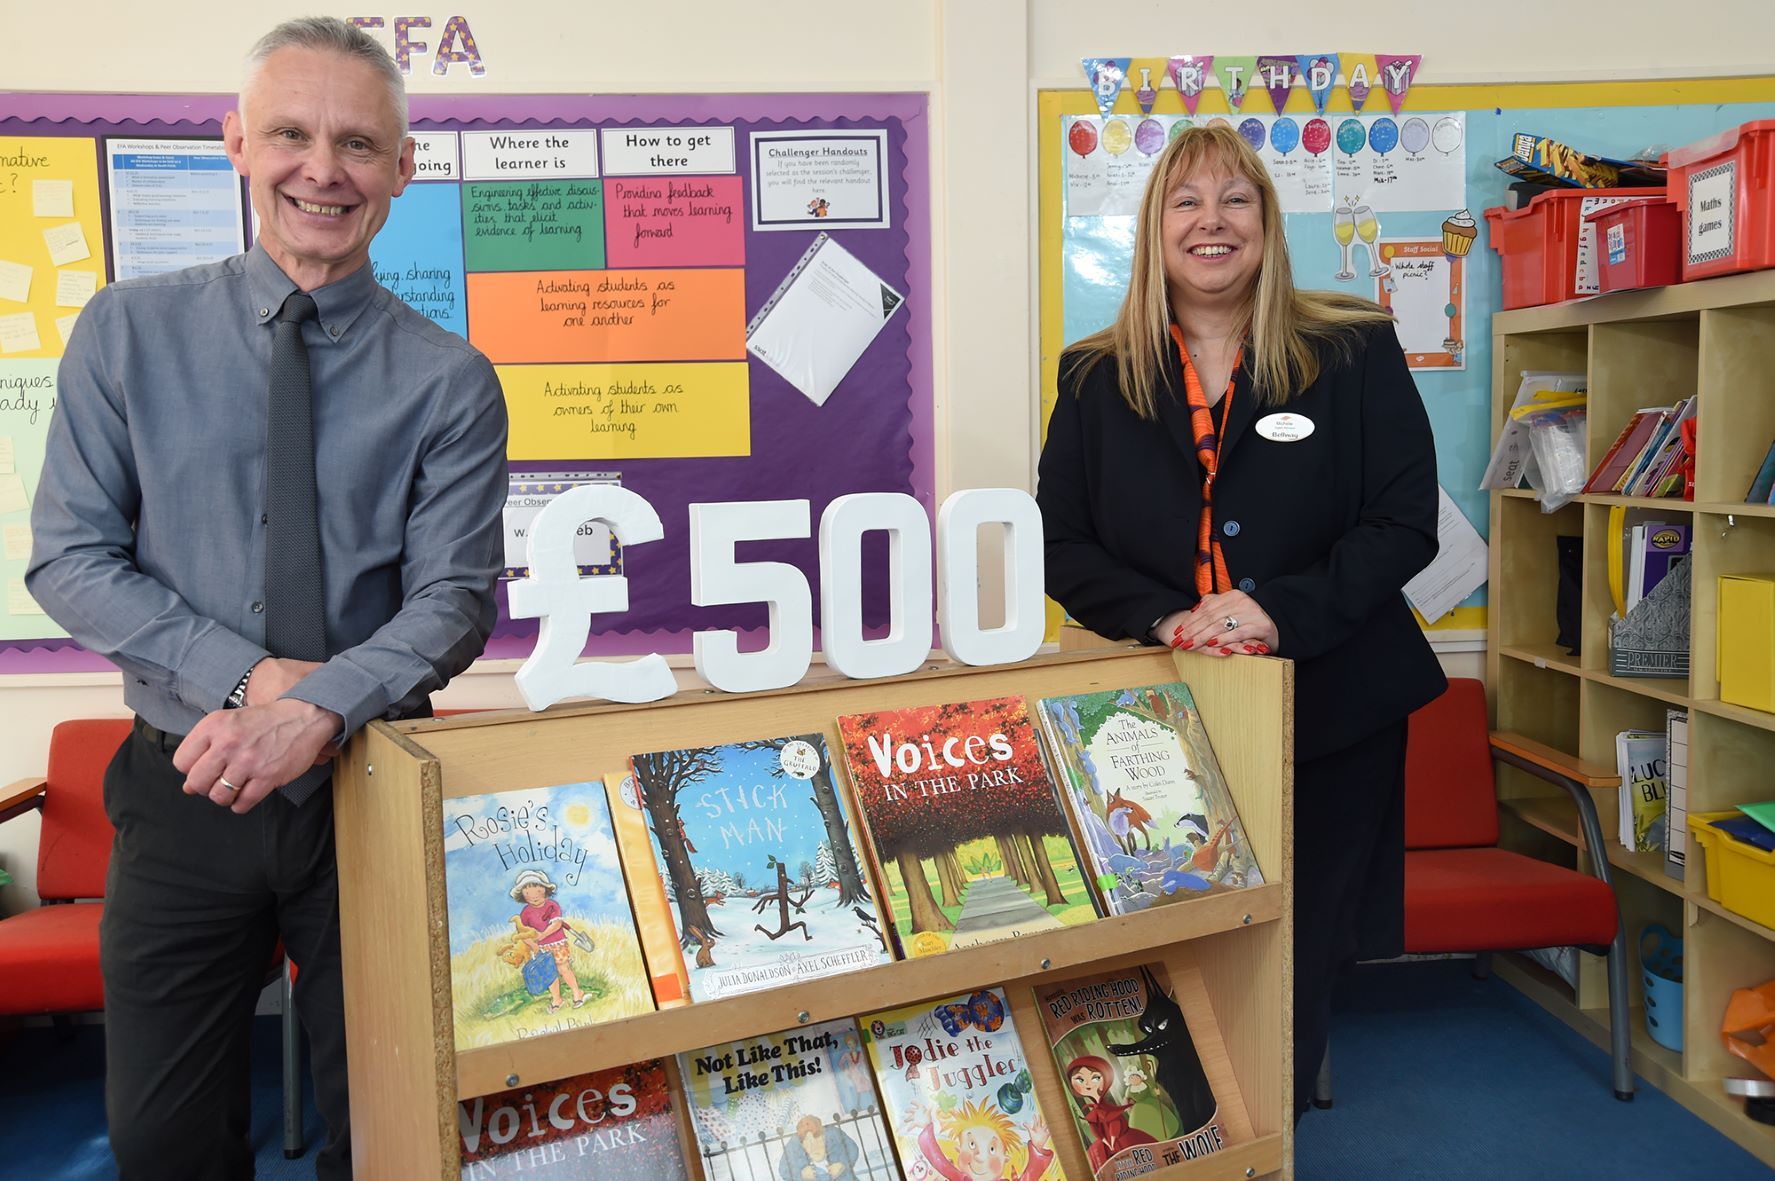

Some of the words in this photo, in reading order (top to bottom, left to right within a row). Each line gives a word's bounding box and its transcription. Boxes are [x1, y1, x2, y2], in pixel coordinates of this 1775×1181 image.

[345, 15, 486, 76] FA
[490, 136, 540, 150] Where
[545, 135, 569, 148] the
[626, 135, 660, 147] How
[666, 135, 682, 147] to
[687, 134, 712, 151] get
[769, 148, 819, 158] Challenger
[822, 147, 868, 156] Handouts
[1514, 134, 1535, 163] Jenga
[413, 159, 451, 176] oing
[495, 157, 549, 170] learner
[554, 157, 567, 169] is
[650, 154, 689, 167] there
[667, 181, 715, 204] feedback
[508, 199, 536, 211] tasks
[541, 198, 562, 210] and
[623, 203, 647, 218] that
[652, 207, 684, 217] moves
[688, 201, 733, 224] learning
[1700, 197, 1722, 213] Maths
[504, 213, 526, 223] that
[530, 211, 559, 223] elicit
[1698, 218, 1722, 236] games
[475, 224, 516, 237] evidence
[521, 224, 535, 242] of
[539, 223, 583, 242] learning
[634, 222, 673, 248] forward
[406, 260, 451, 289] sharing
[1394, 262, 1414, 270] Whole
[537, 279, 590, 297] Activating
[597, 277, 649, 292] students
[656, 281, 676, 291] as
[540, 297, 587, 316] learning
[592, 299, 646, 310] resources
[651, 292, 671, 315] for
[563, 316, 585, 327] one
[591, 312, 635, 326] another
[544, 381, 602, 402] Activating
[607, 380, 657, 395] students
[662, 384, 684, 394] as
[553, 405, 593, 417] owners
[600, 400, 614, 421] of
[620, 400, 646, 415] their
[653, 402, 679, 414] own
[591, 419, 638, 440] learning
[507, 485, 1046, 712] £500
[1626, 651, 1678, 669] PREMIER
[1119, 719, 1136, 730] The
[1106, 727, 1159, 746] ANIMALS
[1131, 740, 1140, 753] of
[1110, 750, 1170, 769] FARTHING
[1124, 765, 1166, 781] WOOD
[883, 783, 908, 801] IN
[914, 776, 963, 798] THE
[968, 767, 1024, 790] PARK
[696, 783, 788, 819] STICK
[454, 800, 549, 848] Rosie's
[719, 817, 789, 850] MAN
[494, 825, 588, 886] Holiday
[718, 974, 742, 989] JULIA
[742, 965, 791, 984] DONALDSON
[797, 959, 821, 975] AXEL
[821, 949, 868, 968] SCHEFFLER
[1049, 995, 1072, 1020] RED
[1070, 983, 1110, 1006] RIDING
[1110, 978, 1139, 998] HOOD
[1071, 1012, 1087, 1024] WAS
[1086, 996, 1145, 1020] ROTTEN!
[695, 1053, 734, 1076] Not
[736, 1044, 782, 1067] Like
[783, 1031, 839, 1056] That,
[889, 1038, 959, 1072] Jodie
[965, 1036, 993, 1053] the
[722, 1072, 769, 1095] Like
[771, 1056, 822, 1083] This!
[926, 1053, 1017, 1091] Juggler
[468, 1160, 497, 1181] IN
[513, 1141, 567, 1172] THE
[576, 1123, 647, 1156] PARK
[1132, 1147, 1153, 1166] RED
